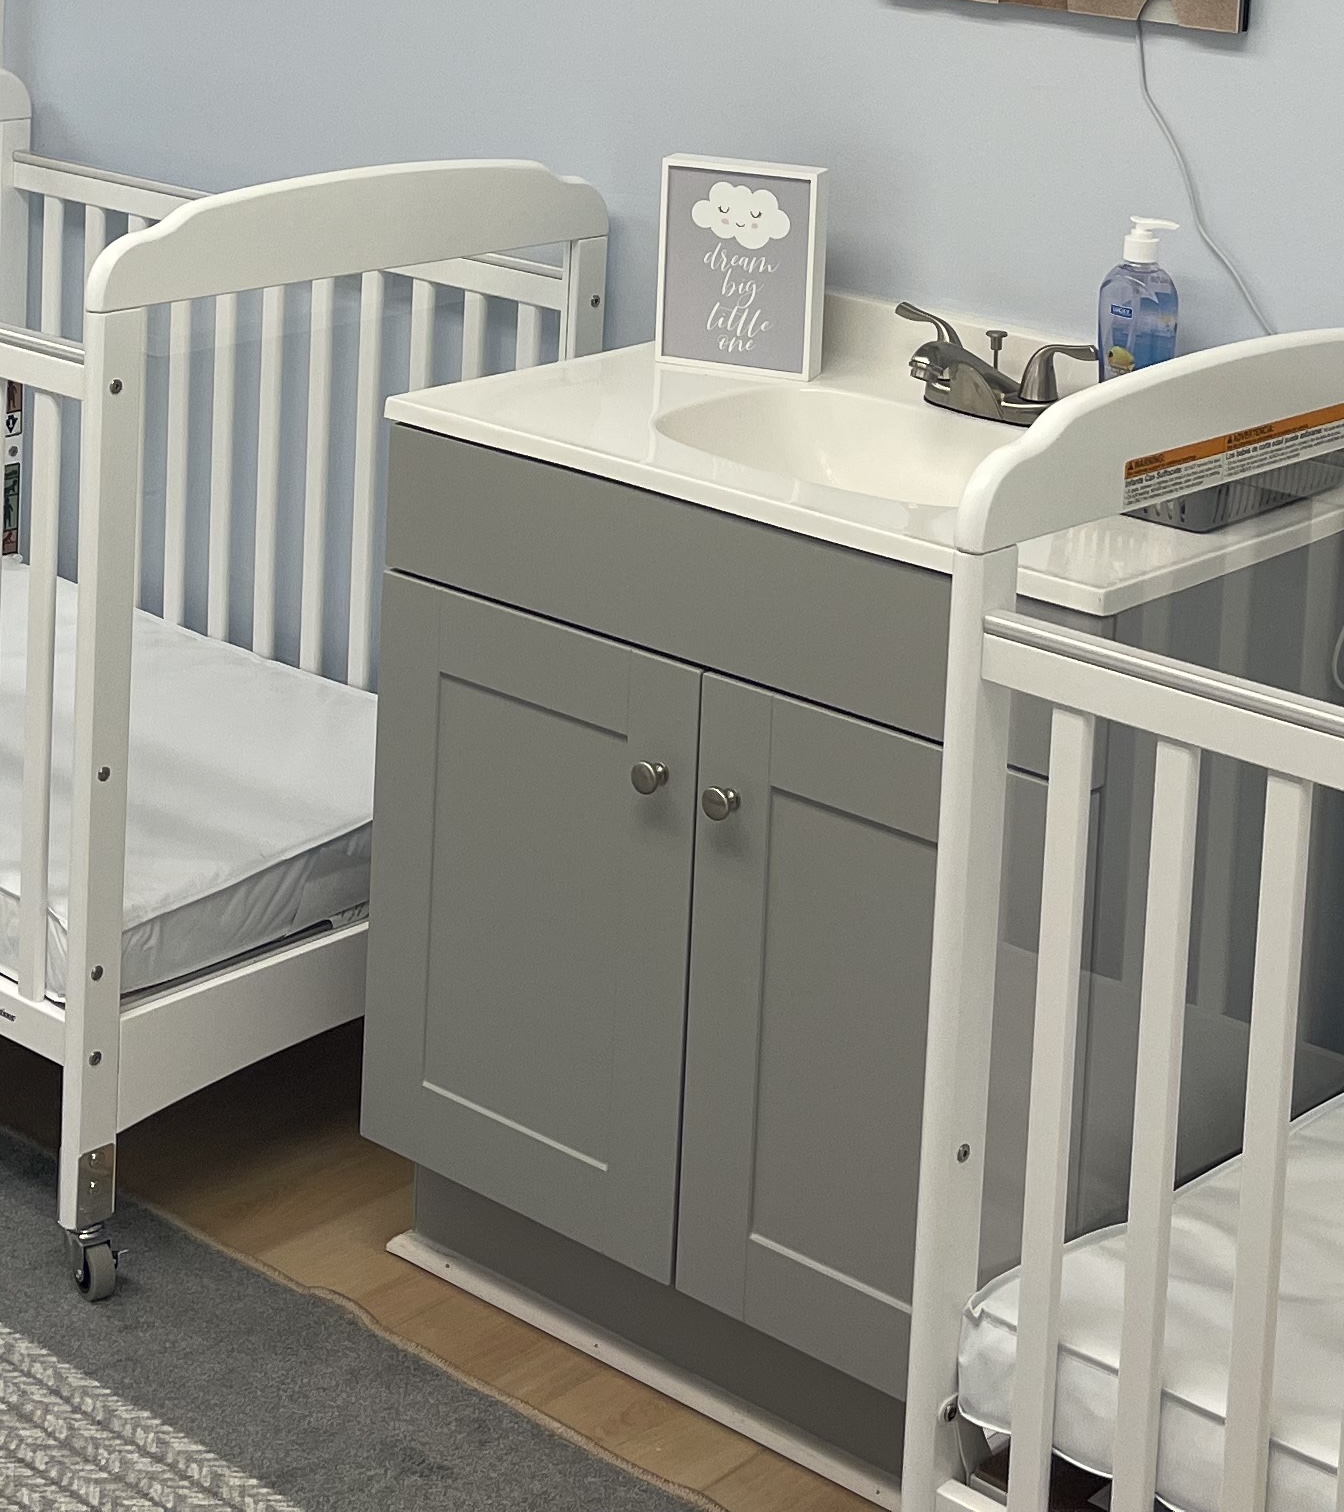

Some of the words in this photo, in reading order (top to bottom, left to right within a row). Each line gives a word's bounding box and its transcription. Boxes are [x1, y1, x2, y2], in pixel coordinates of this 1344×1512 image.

[704, 242, 780, 274] dream
[722, 268, 764, 309] big
[707, 302, 773, 338] little
[717, 334, 757, 353] one
